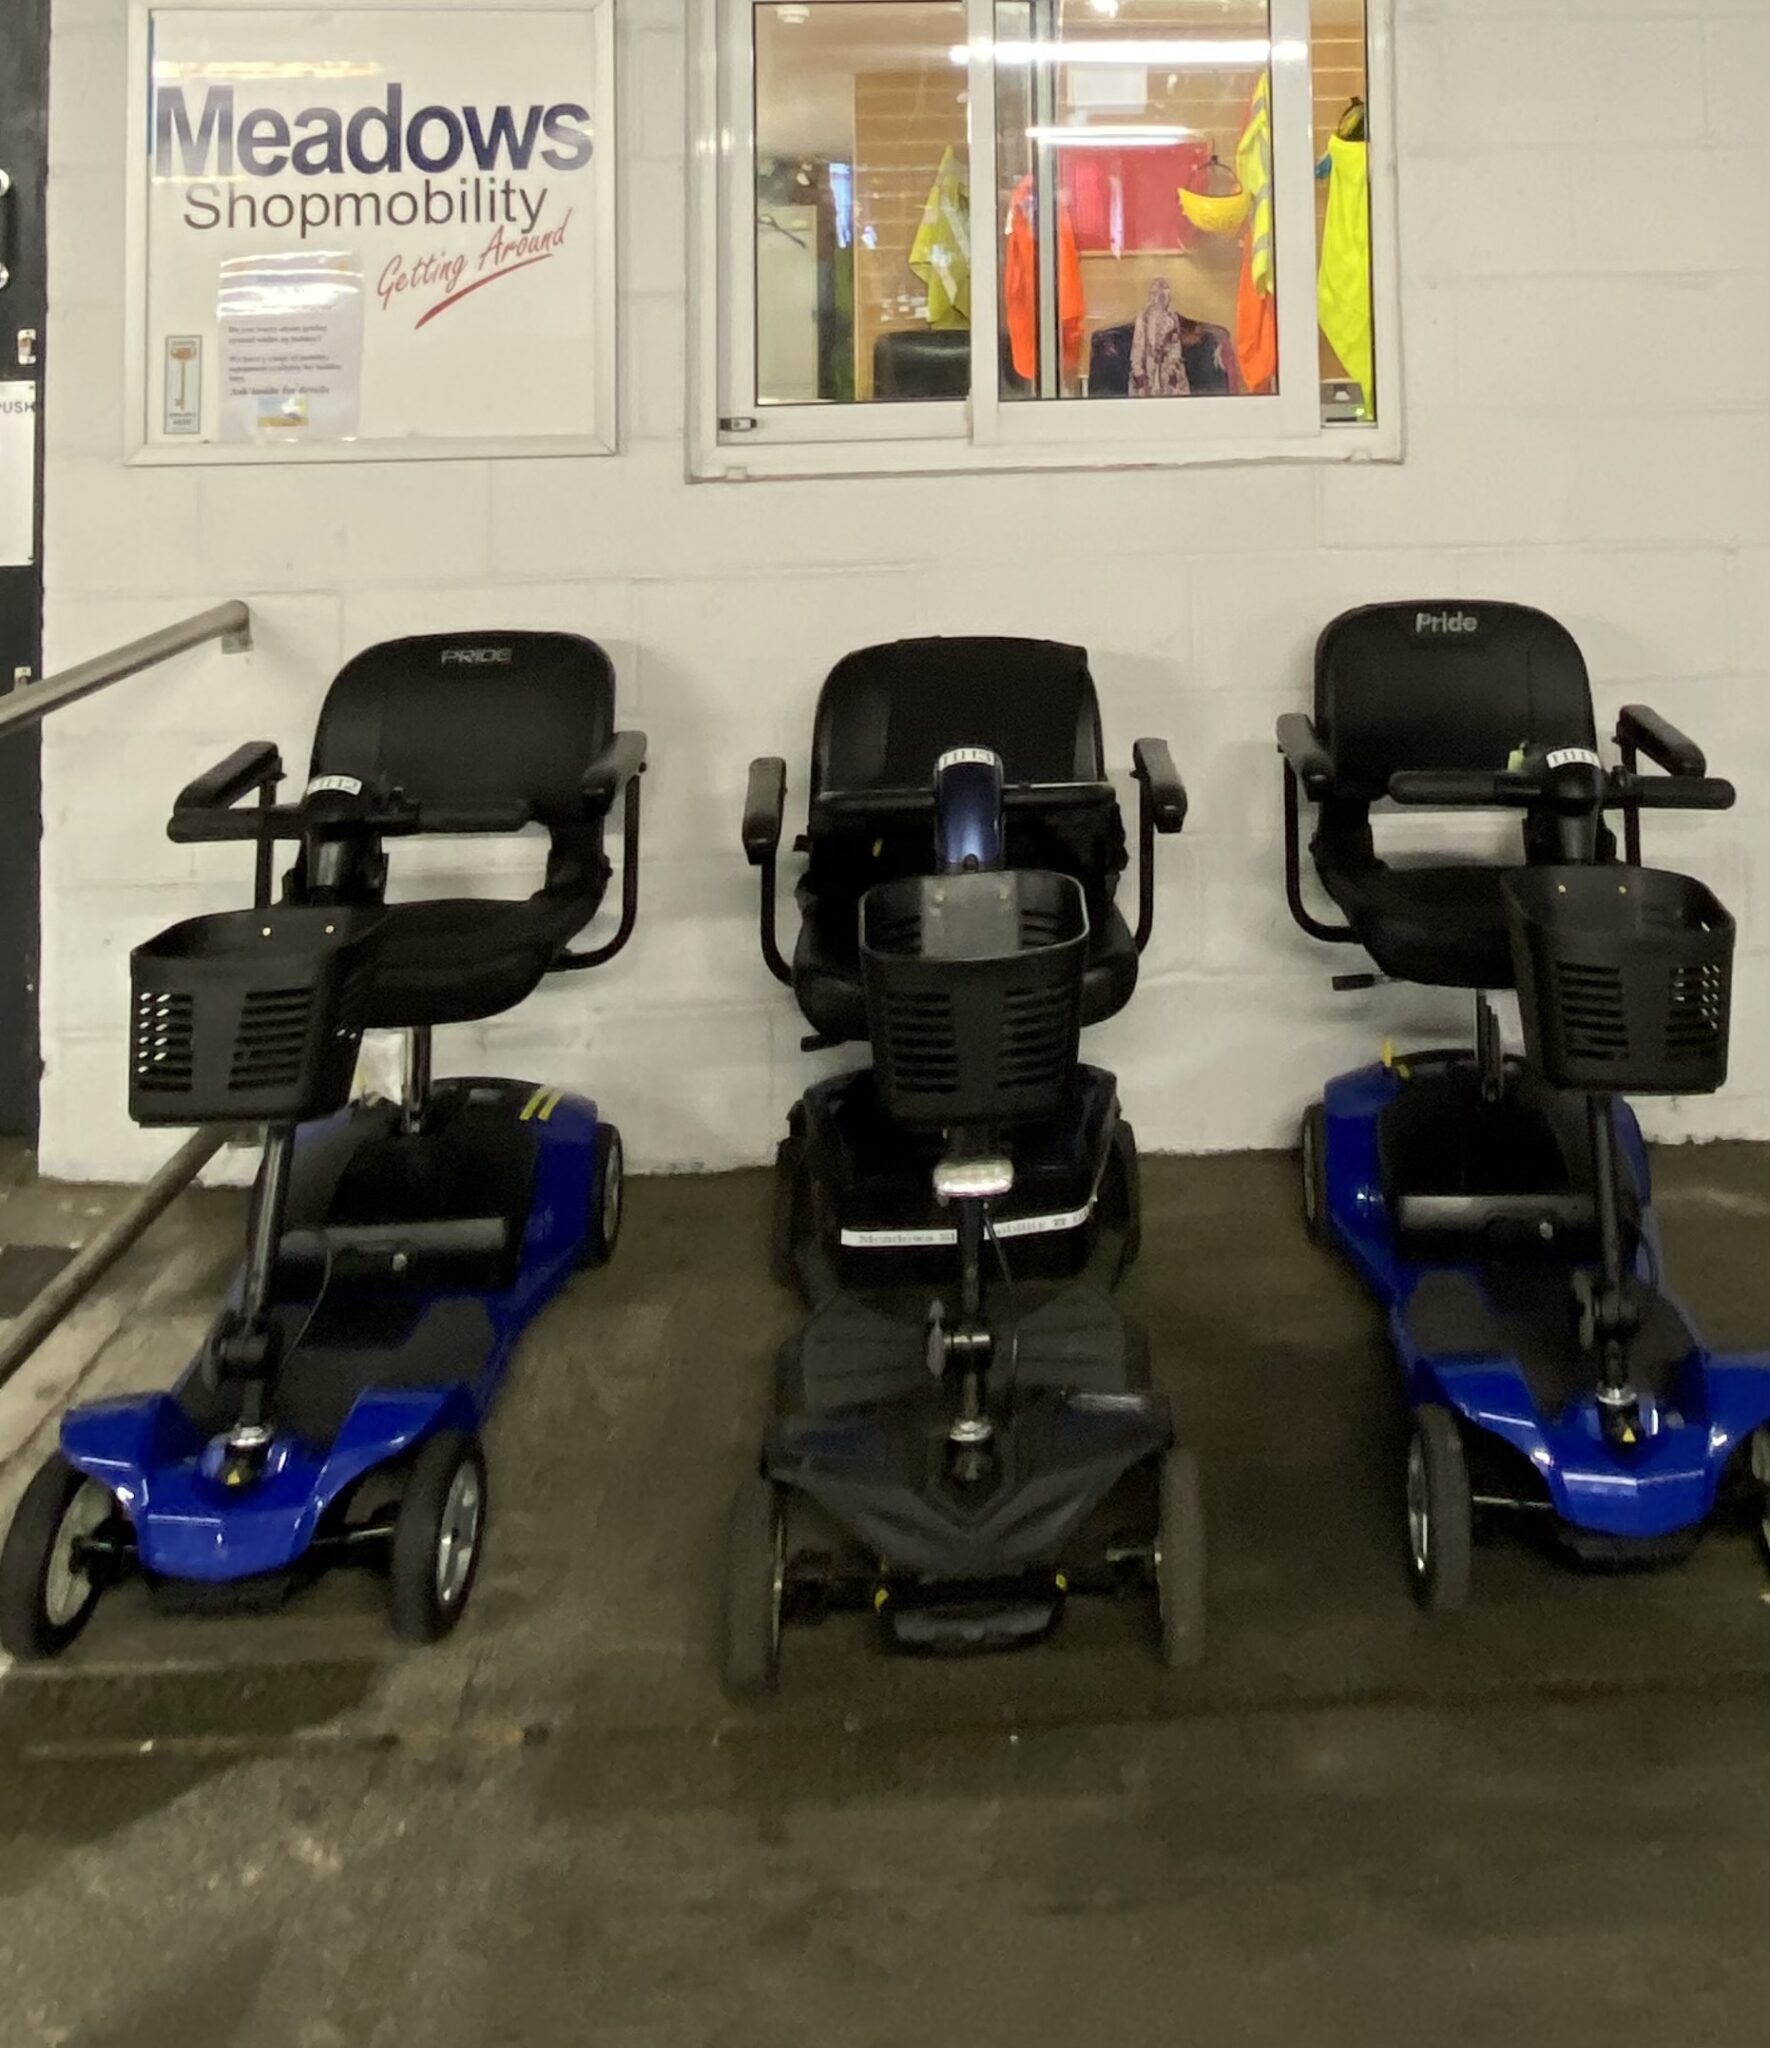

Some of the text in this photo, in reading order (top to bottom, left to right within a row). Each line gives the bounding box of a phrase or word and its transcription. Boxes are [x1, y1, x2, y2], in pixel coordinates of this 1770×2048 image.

[155, 82, 594, 177] Meadows
[183, 178, 548, 238] Shopmobility
[377, 207, 573, 310] Getting Around
[0, 401, 34, 414] USH
[1415, 610, 1478, 633] Pride
[441, 647, 513, 664] PRIDE
